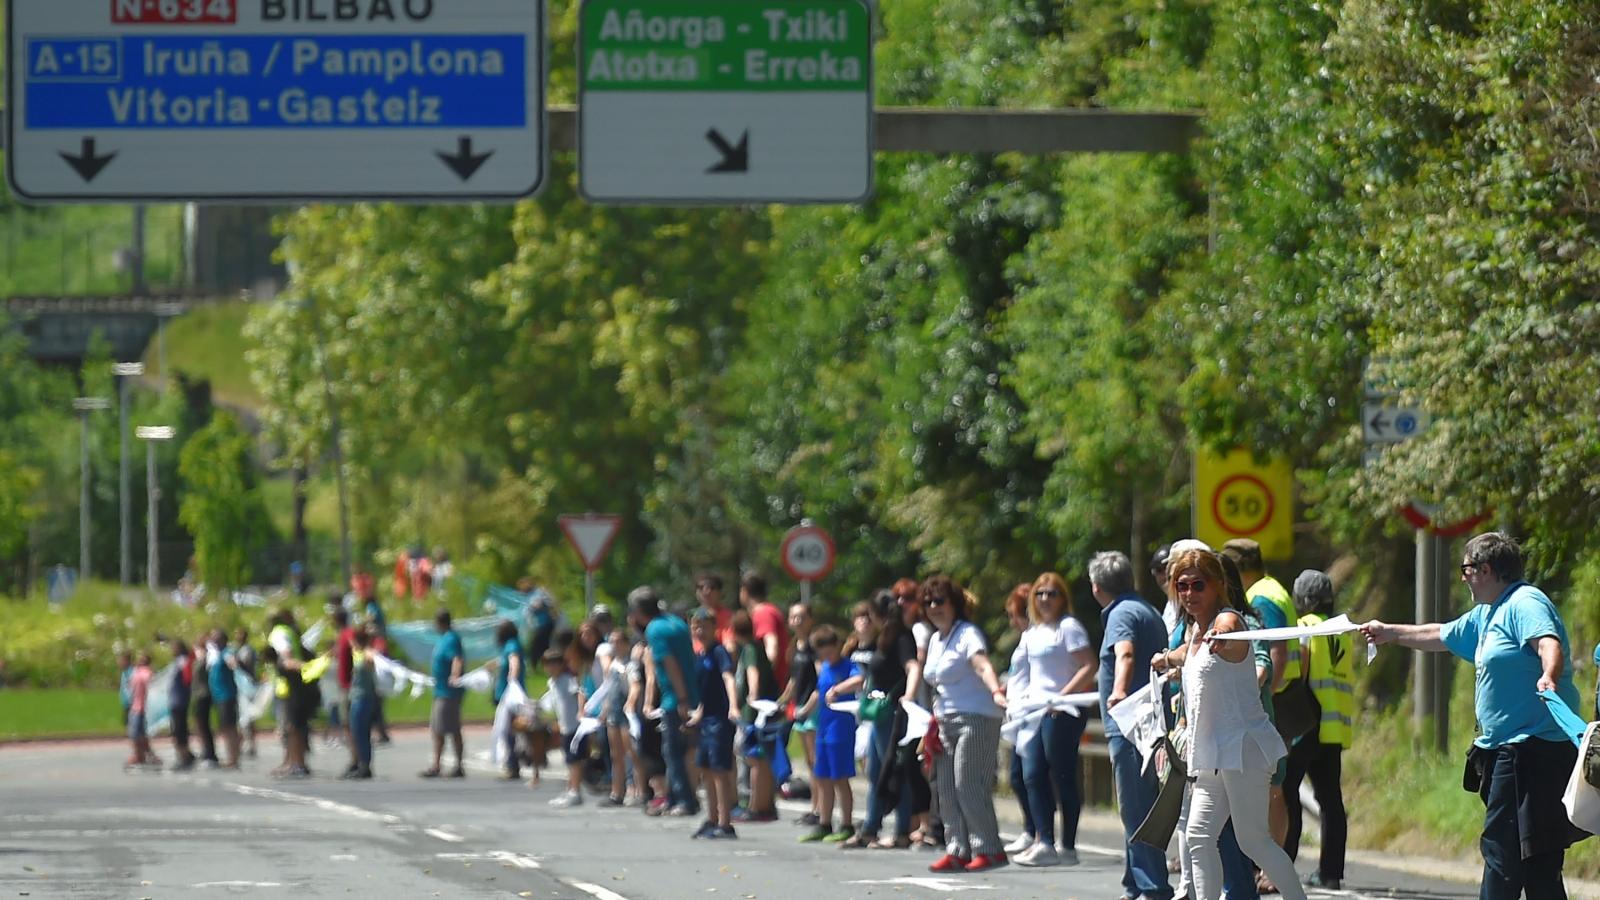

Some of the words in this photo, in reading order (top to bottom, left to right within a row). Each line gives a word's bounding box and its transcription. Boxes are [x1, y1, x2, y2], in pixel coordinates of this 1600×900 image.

[261, 0, 433, 21] BILBAO
[599, 9, 725, 48] Añorga
[763, 9, 848, 42] Txiki
[34, 44, 113, 73] A-15
[143, 40, 250, 75] Iruña
[261, 41, 281, 77] /
[292, 39, 504, 83] Pamplona
[587, 49, 698, 81] Atotxa
[745, 49, 861, 81] Erreka
[1225, 495, 1261, 517] 50
[793, 543, 823, 562] 40
